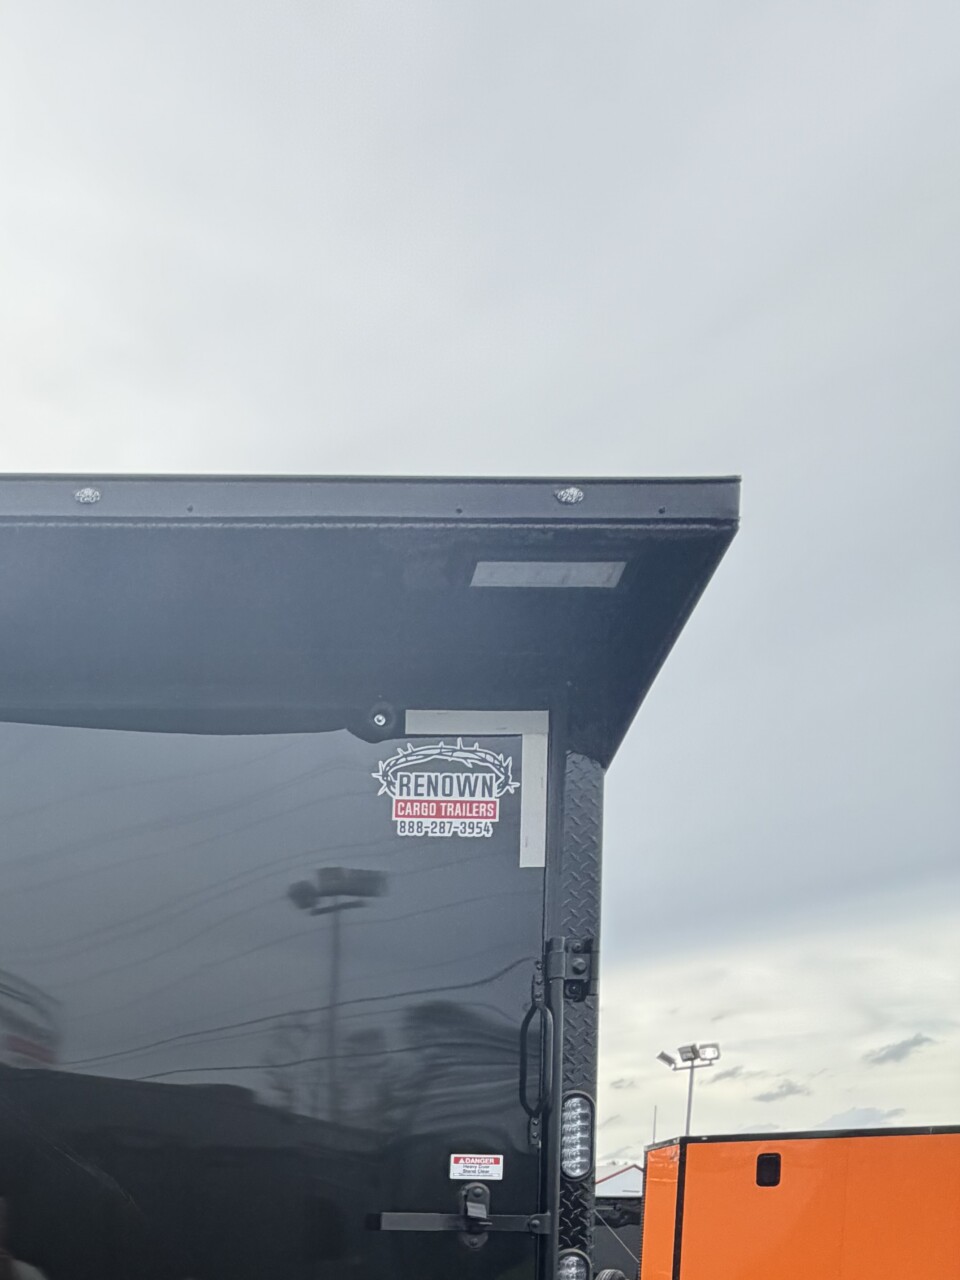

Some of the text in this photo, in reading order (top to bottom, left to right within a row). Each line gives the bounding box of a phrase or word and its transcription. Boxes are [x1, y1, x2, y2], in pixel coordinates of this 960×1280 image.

[398, 774, 494, 798] RENOWN
[397, 802, 494, 817] CARGO TRAILERS
[399, 820, 491, 835] 888-287-3954
